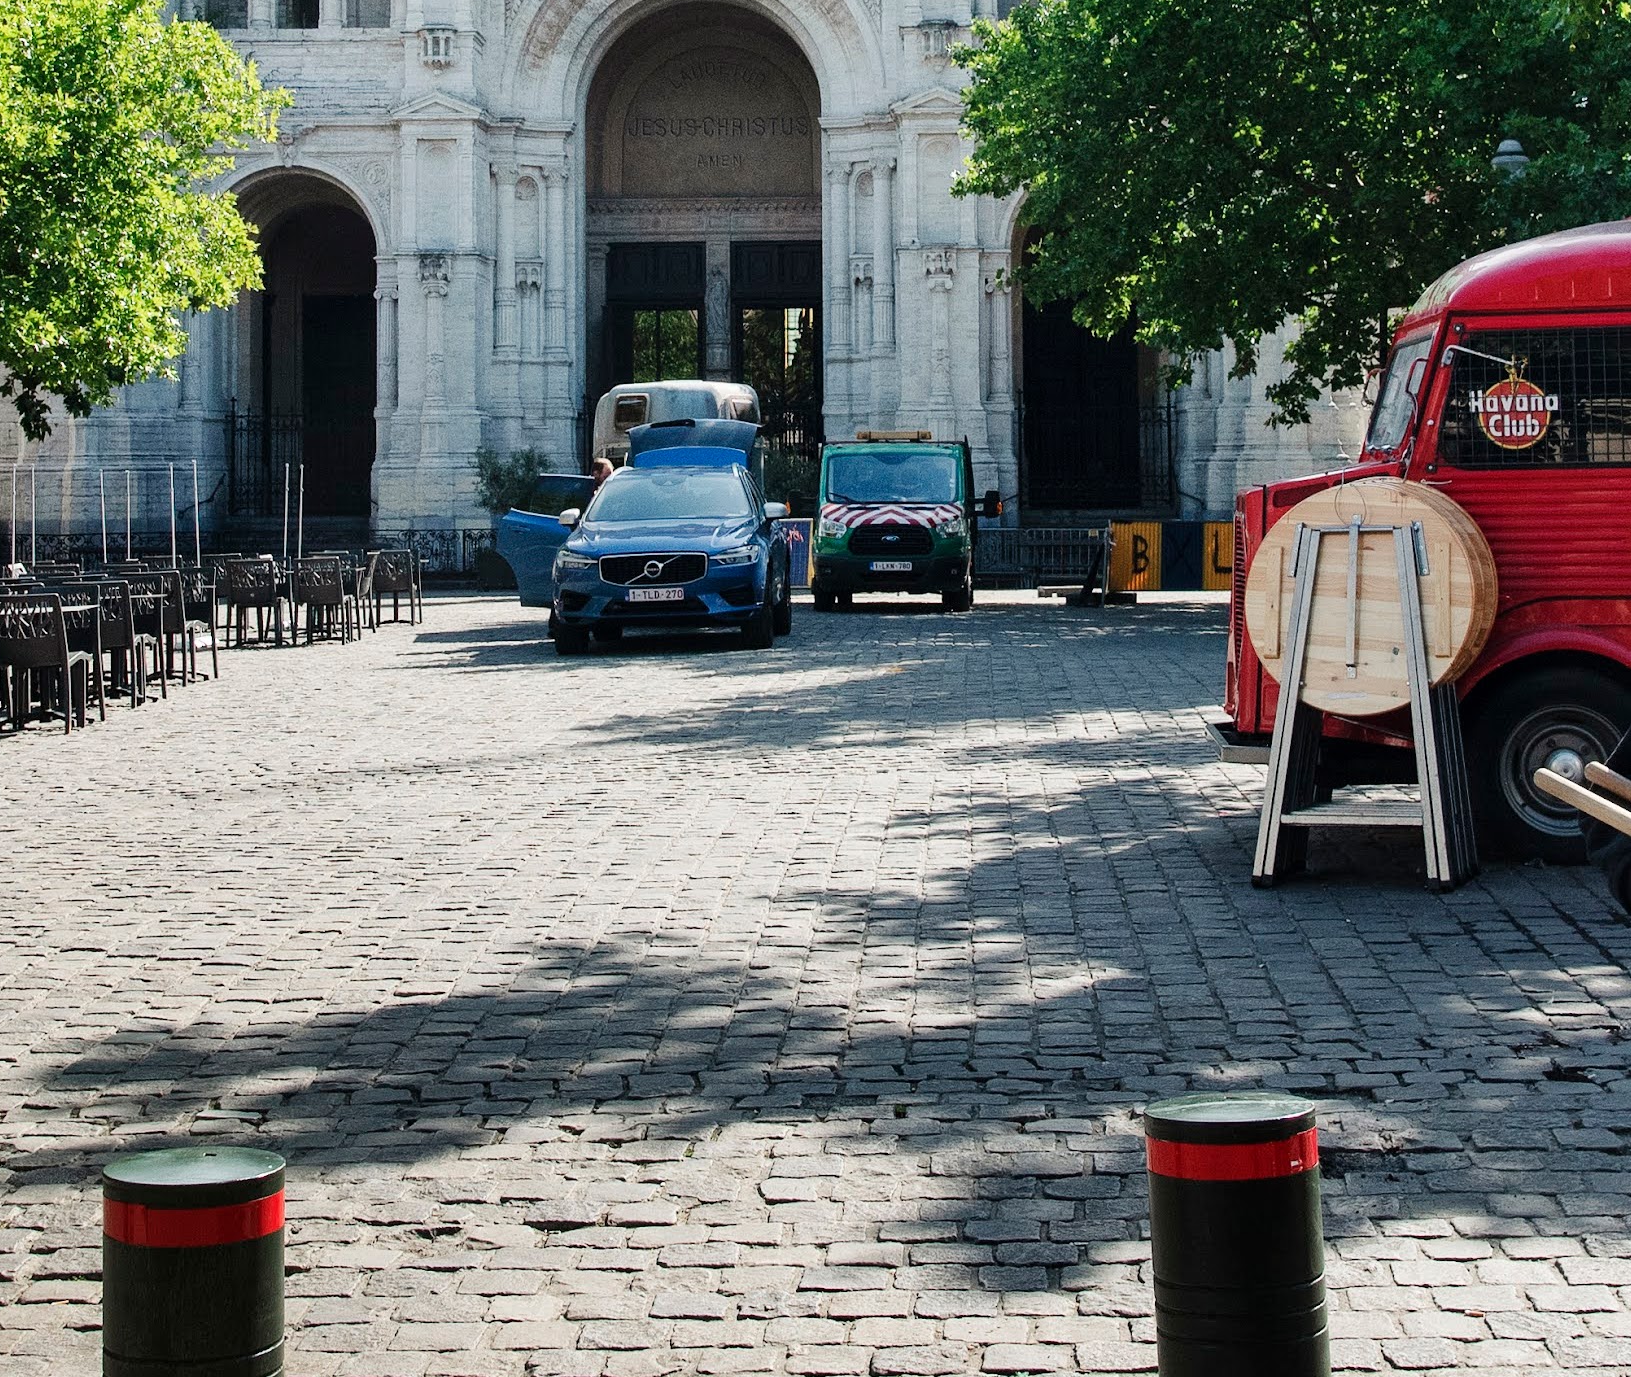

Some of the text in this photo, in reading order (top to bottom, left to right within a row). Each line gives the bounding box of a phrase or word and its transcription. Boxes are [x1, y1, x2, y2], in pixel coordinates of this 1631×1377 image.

[697, 155, 743, 167] AMEN
[1469, 390, 1559, 413] Havana
[1488, 414, 1540, 437] Club
[632, 589, 683, 599] 1-TLD-270
